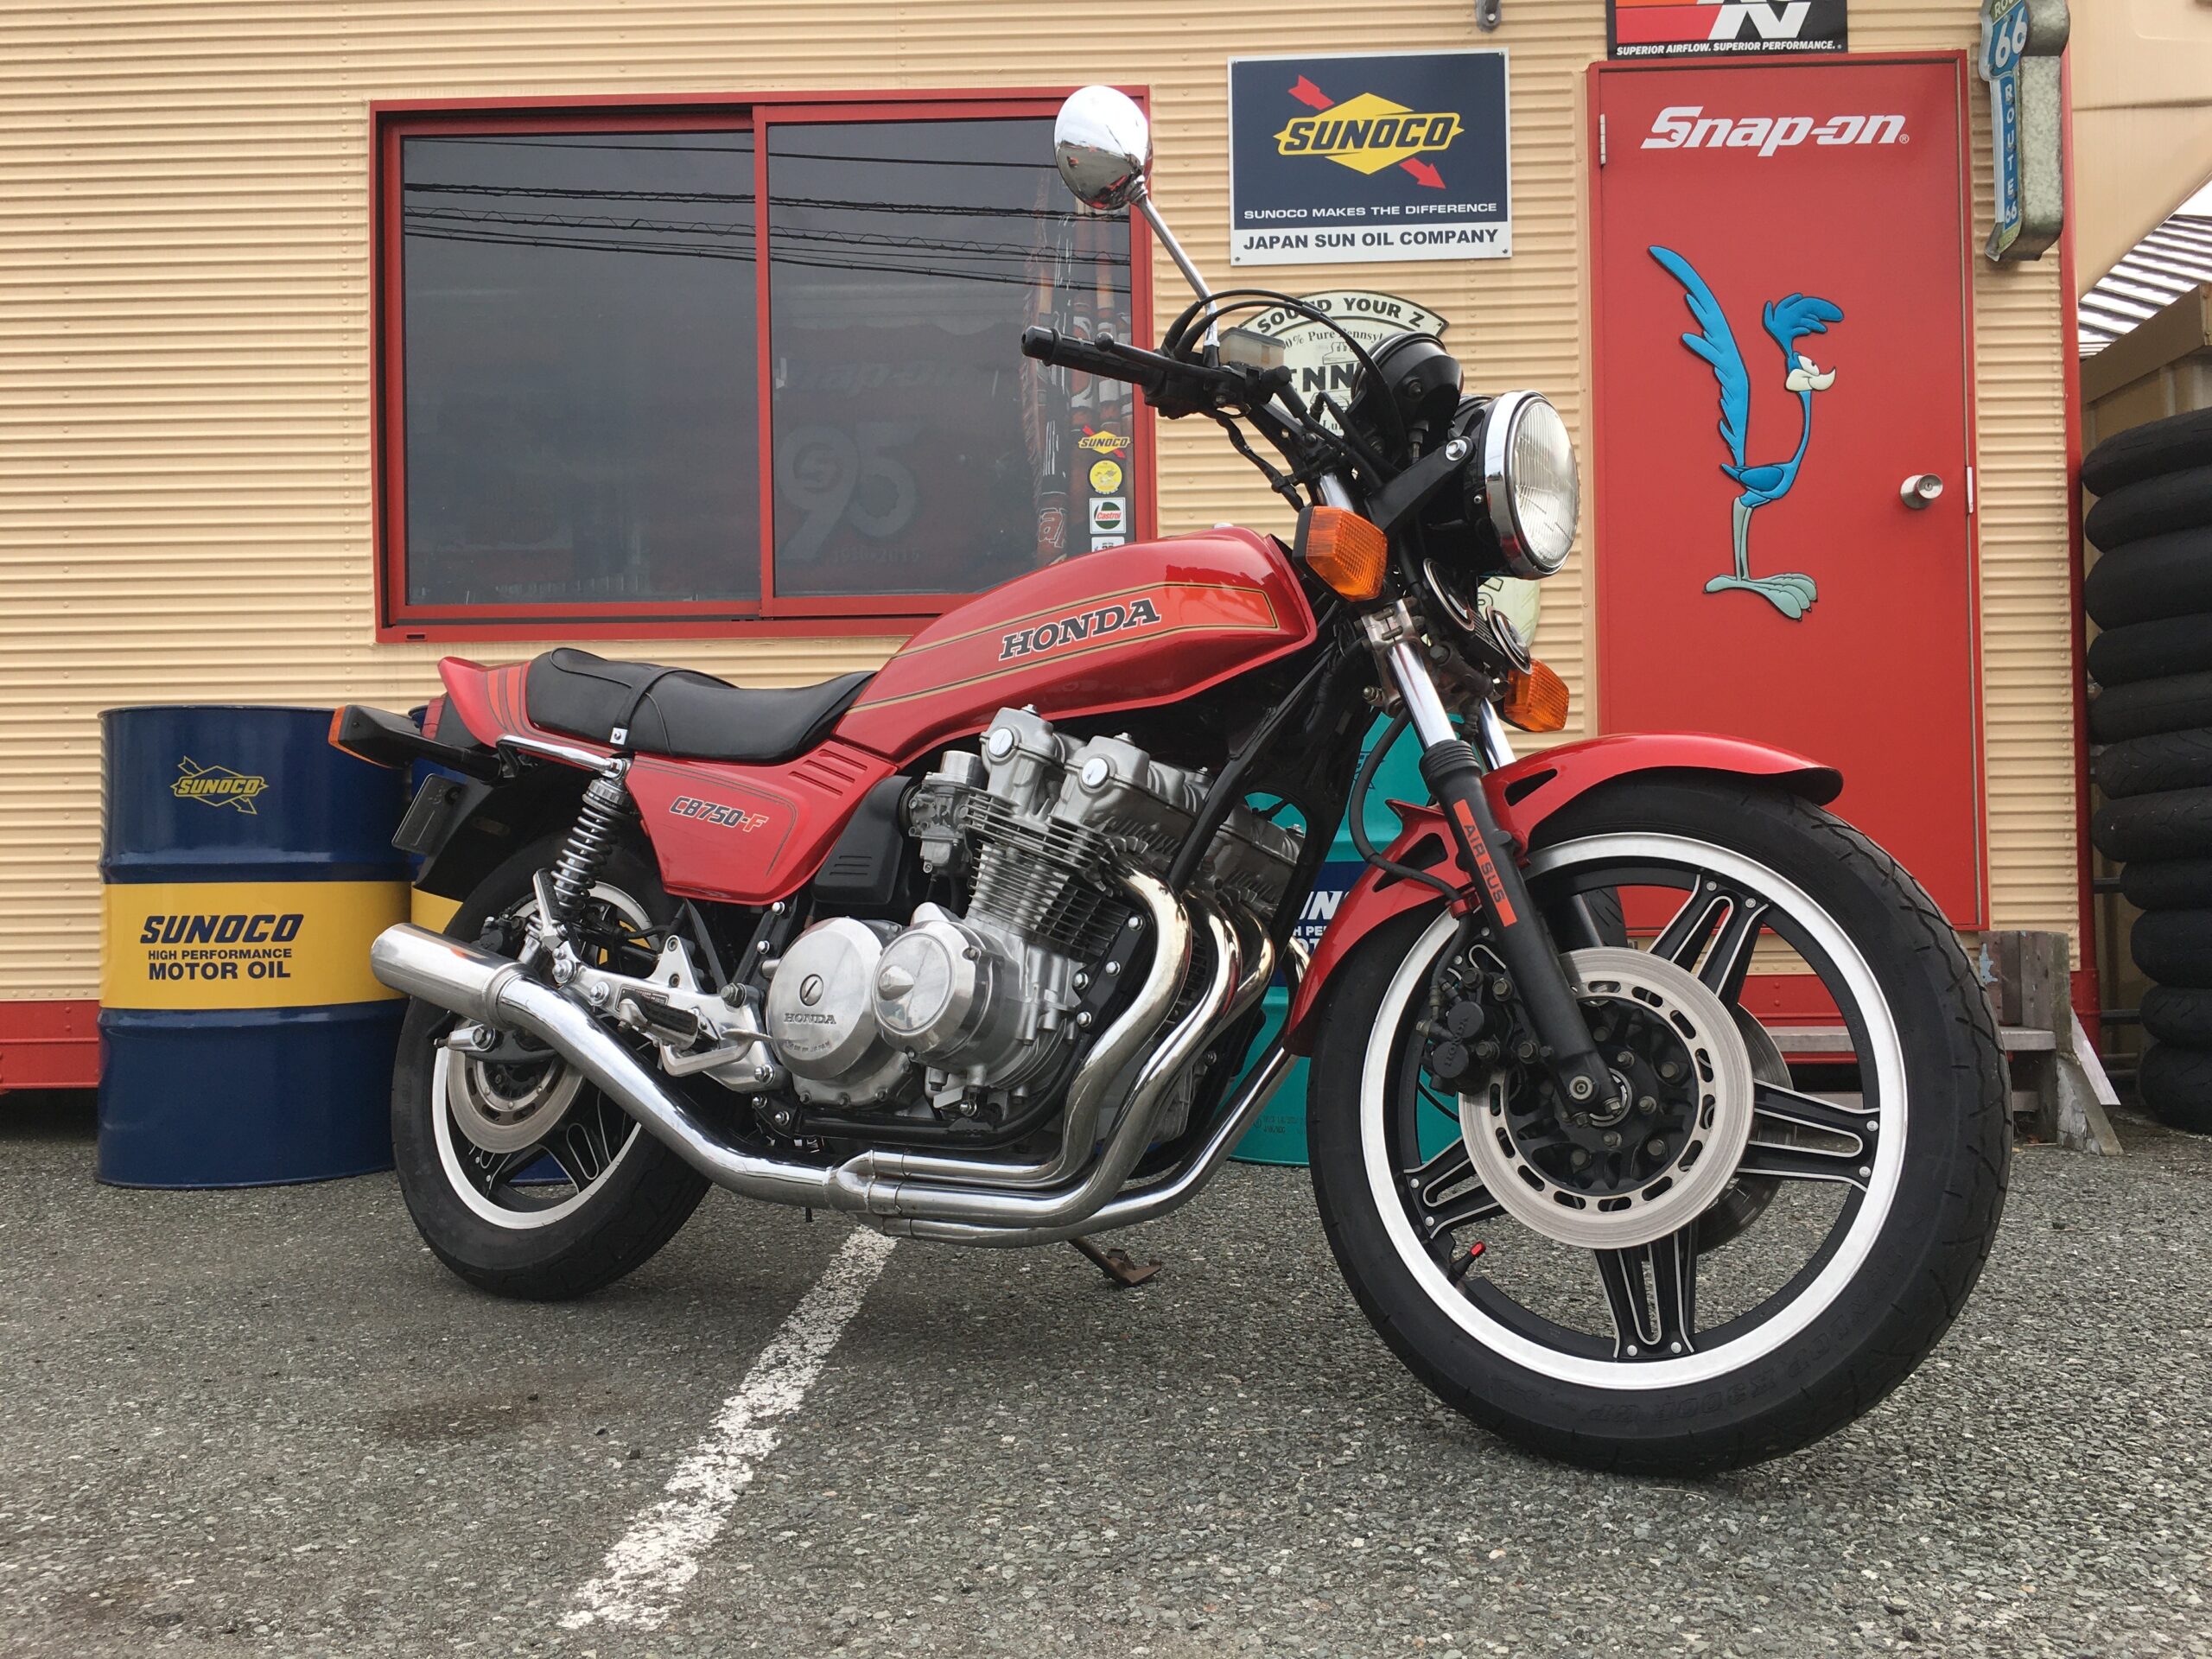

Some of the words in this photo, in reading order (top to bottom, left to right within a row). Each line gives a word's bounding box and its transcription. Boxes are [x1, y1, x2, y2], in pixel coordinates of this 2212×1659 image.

[1995, 6, 2028, 68] 66
[1617, 45, 1664, 56] SUPERIOR
[1666, 43, 1711, 54] AIRFLOW.
[1713, 41, 1762, 52] SUPERIOR
[1283, 116, 1453, 151] SUNOCO
[1243, 209, 1307, 219] SUNOCO
[1313, 207, 1365, 217] MAKES
[1371, 206, 1401, 215] THE
[1405, 203, 1497, 215] DIFFERENCE
[2005, 200, 2018, 224] 66
[1243, 234, 1309, 251] JAPAN
[1314, 233, 1355, 247] SUN
[1362, 232, 1394, 246] OIL
[1400, 229, 1498, 245] COMPANY
[1343, 297, 1402, 319] YOUR
[1408, 311, 1425, 328] Z
[1307, 330, 1335, 342] Pure
[1080, 438, 1128, 448] SUNOCO
[1096, 510, 1122, 520] Castrol
[999, 598, 1161, 661] HONDA
[177, 778, 261, 795] SUNOCO
[670, 796, 770, 832] CB750-F
[1464, 824, 1486, 858] AIR
[1480, 861, 1504, 904] SUS
[140, 913, 304, 944] SUNOCO
[148, 950, 177, 960] HIGH
[181, 948, 292, 959] PERFORMANCE
[149, 963, 238, 980] MOTOR
[248, 962, 290, 978] OIL
[784, 1013, 836, 1025] HONDA
